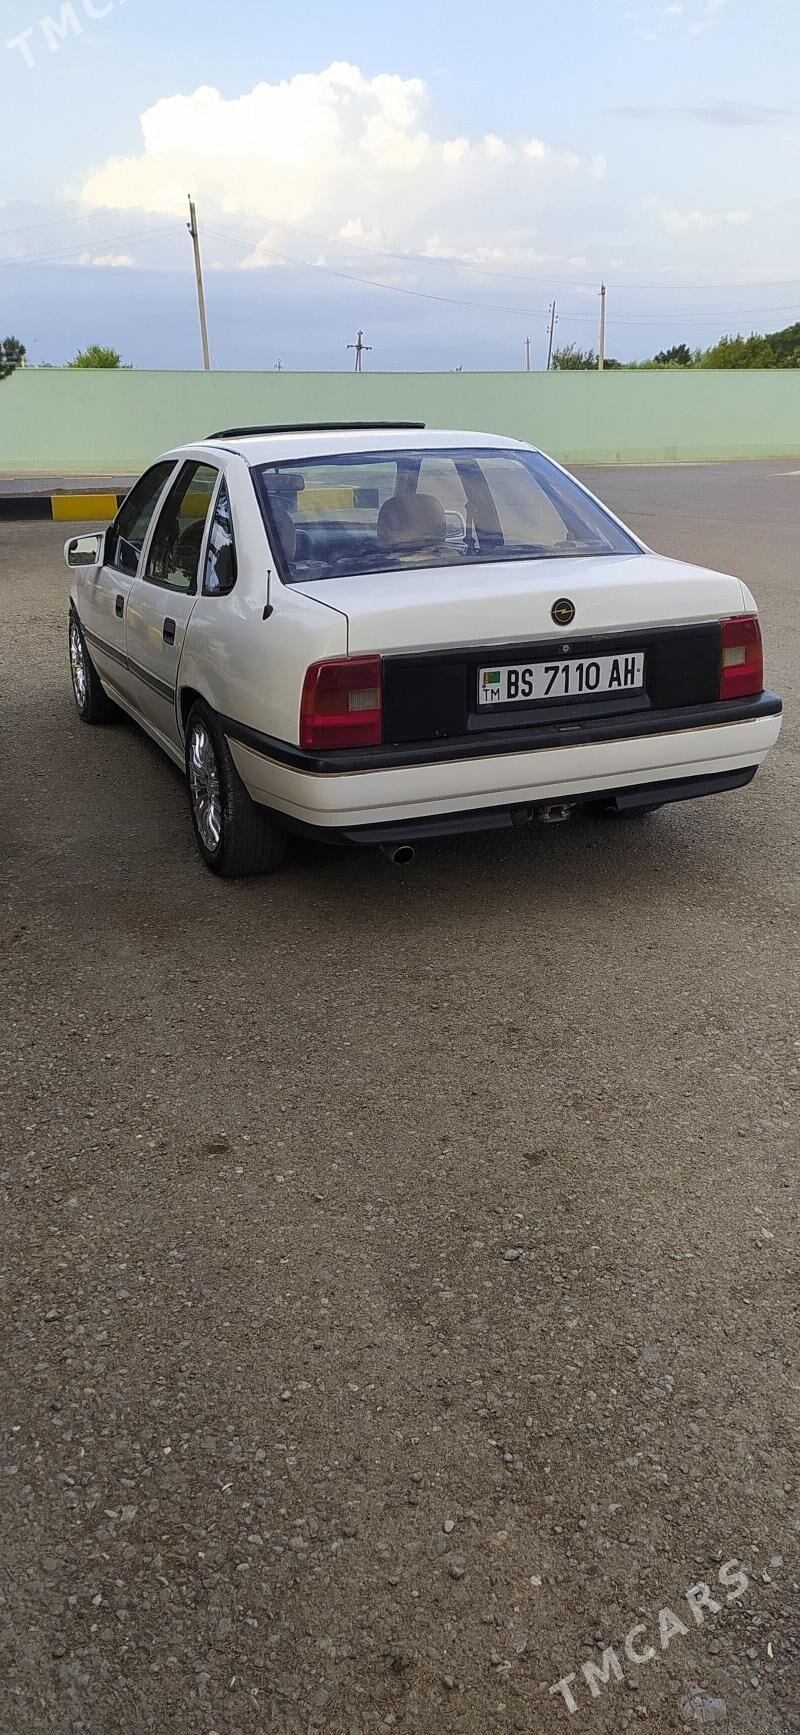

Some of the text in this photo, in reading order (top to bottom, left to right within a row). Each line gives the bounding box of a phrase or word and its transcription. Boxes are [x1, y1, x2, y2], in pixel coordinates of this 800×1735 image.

[507, 657, 636, 699] BS 7110 AH
[482, 688, 500, 702] TM
